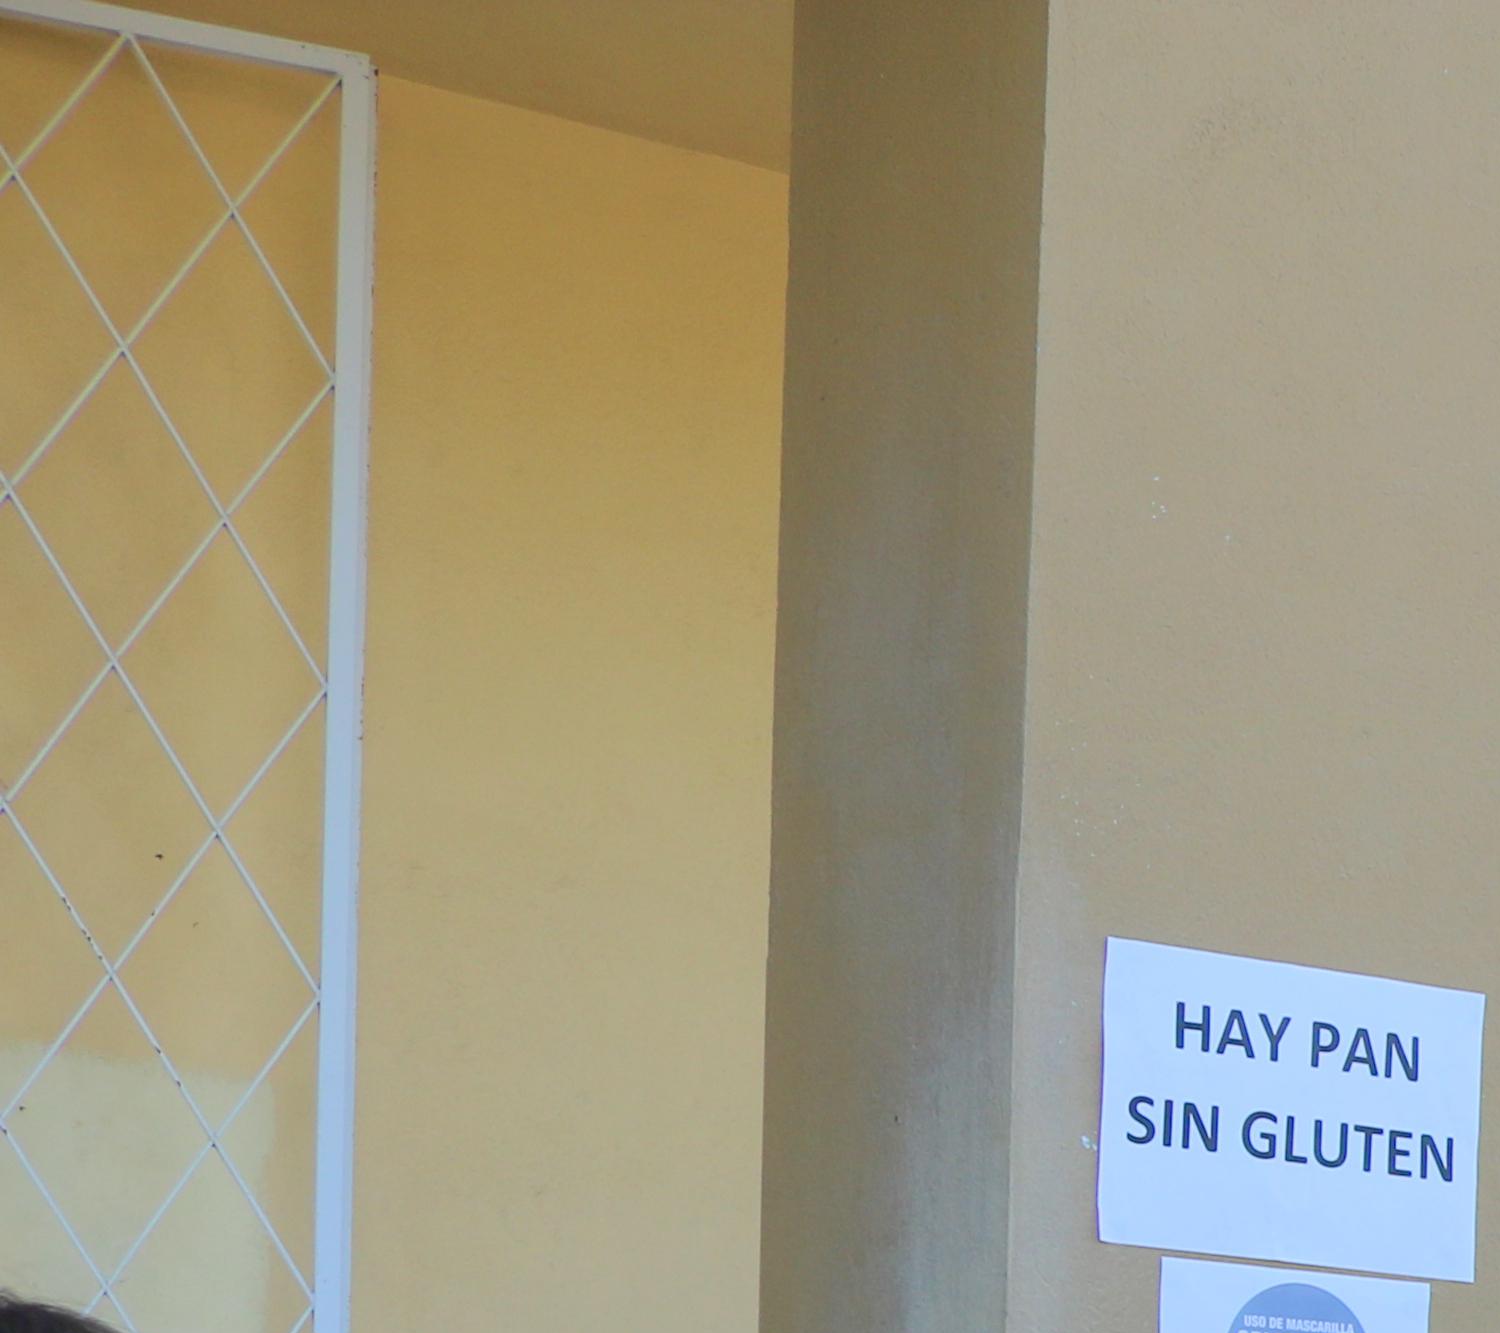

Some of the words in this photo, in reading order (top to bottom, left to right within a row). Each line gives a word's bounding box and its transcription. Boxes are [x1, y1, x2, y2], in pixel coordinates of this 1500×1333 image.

[1175, 1001, 1291, 1062] HAY
[1310, 1021, 1420, 1083] PAN
[1126, 1095, 1220, 1153] SIN
[1241, 1110, 1455, 1183] GLUTEN
[1243, 1314, 1266, 1328] USO
[1269, 1316, 1284, 1330] DE
